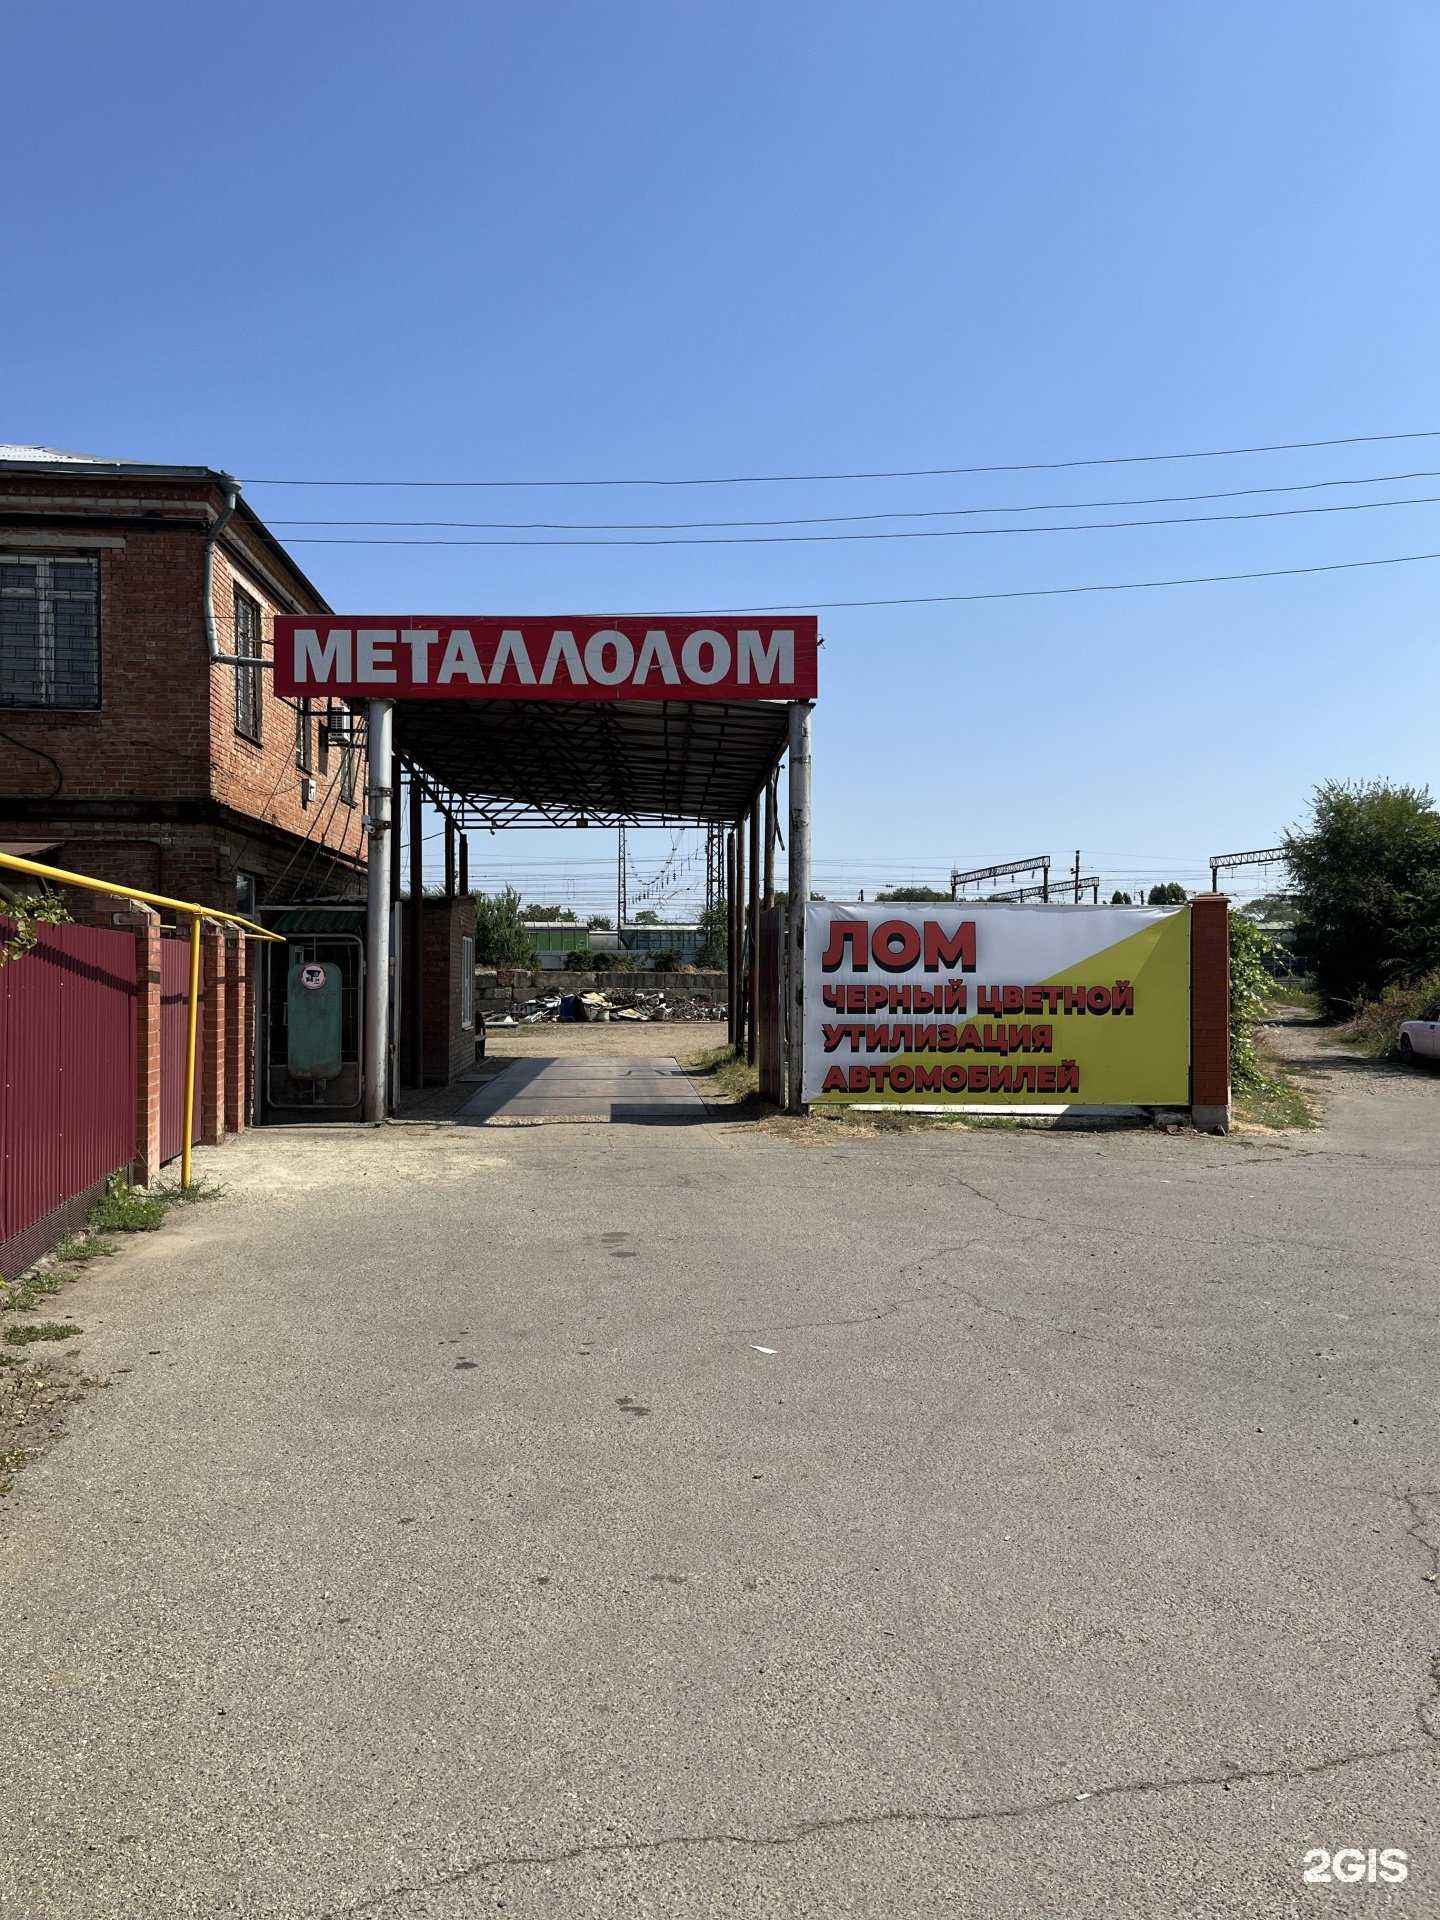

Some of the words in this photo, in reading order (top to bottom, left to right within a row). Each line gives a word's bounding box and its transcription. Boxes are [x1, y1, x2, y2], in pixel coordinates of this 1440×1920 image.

[293, 629, 795, 686] МЕТАЛЛОЛОМ
[822, 920, 977, 973] ЛОМ
[822, 978, 968, 1015] ЧЕРНЫЙ
[976, 980, 1135, 1018] ЦВЕТНОЙ
[821, 1023, 1053, 1056] УТИЛИЗАЦИЯ
[821, 1059, 1080, 1094] АВТОМОБИЛЕЙ
